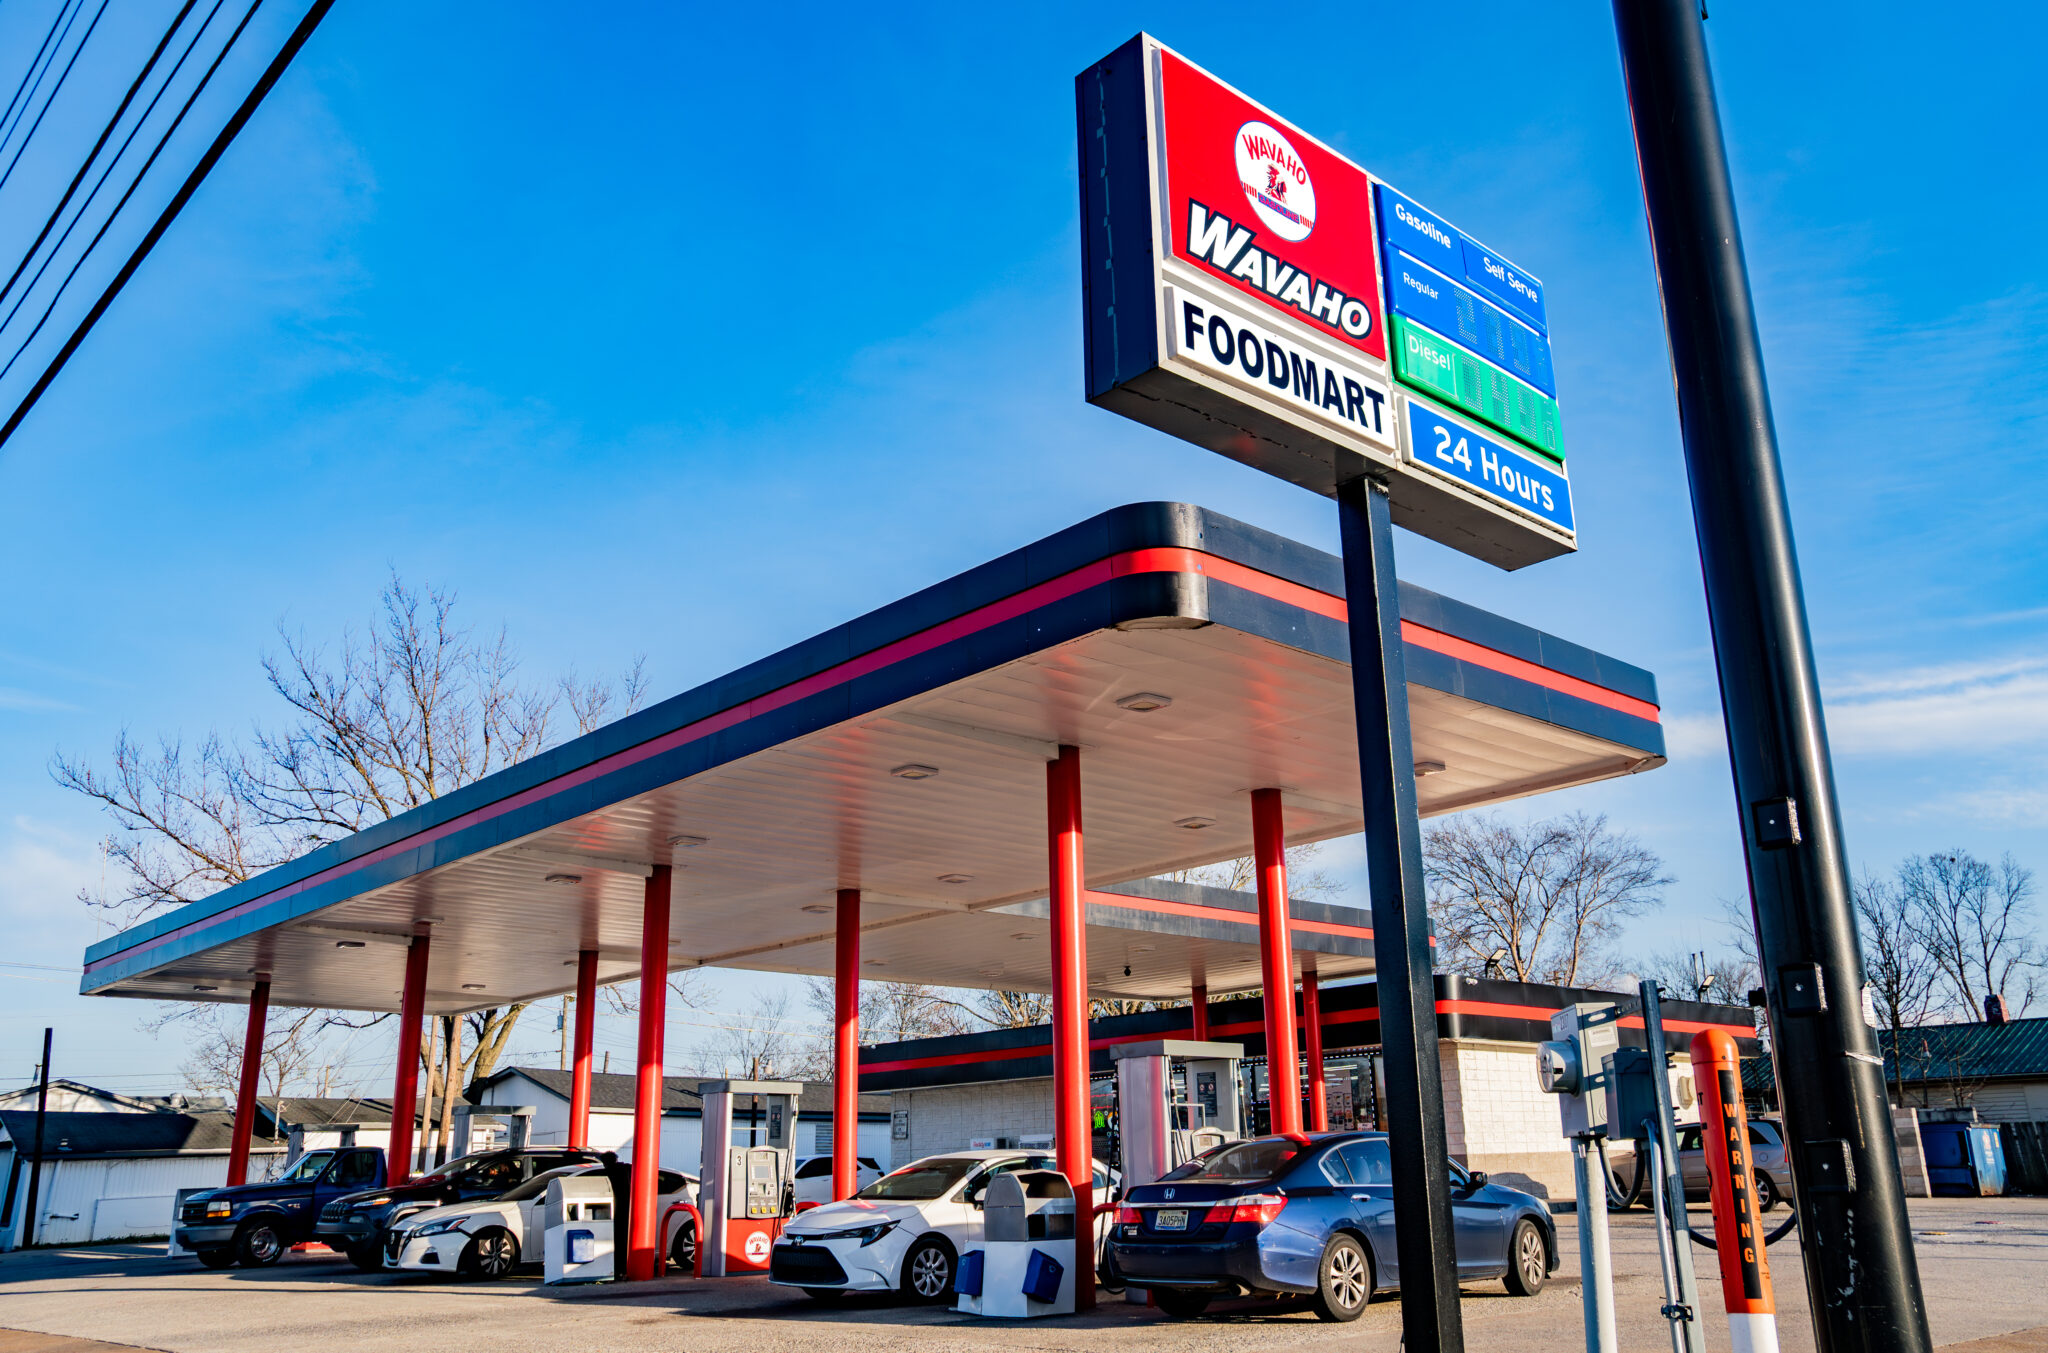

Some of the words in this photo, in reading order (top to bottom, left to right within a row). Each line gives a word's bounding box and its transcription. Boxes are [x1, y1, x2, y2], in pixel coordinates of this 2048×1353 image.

[1242, 134, 1306, 185] WAVAHO
[1258, 194, 1300, 223] GASOLINE
[1395, 203, 1451, 248] Gasoline
[1187, 198, 1372, 339] WAVAHO
[1403, 272, 1439, 299] Regular
[1484, 257, 1505, 281] Self
[1507, 272, 1538, 302] Serve
[1183, 300, 1385, 434] FOODMART
[1409, 334, 1451, 371] Diesel
[1433, 425, 1472, 472] 24
[1480, 446, 1554, 511] Hours
[737, 1155, 742, 1166] 3
[1724, 1103, 1755, 1263] WARNING
